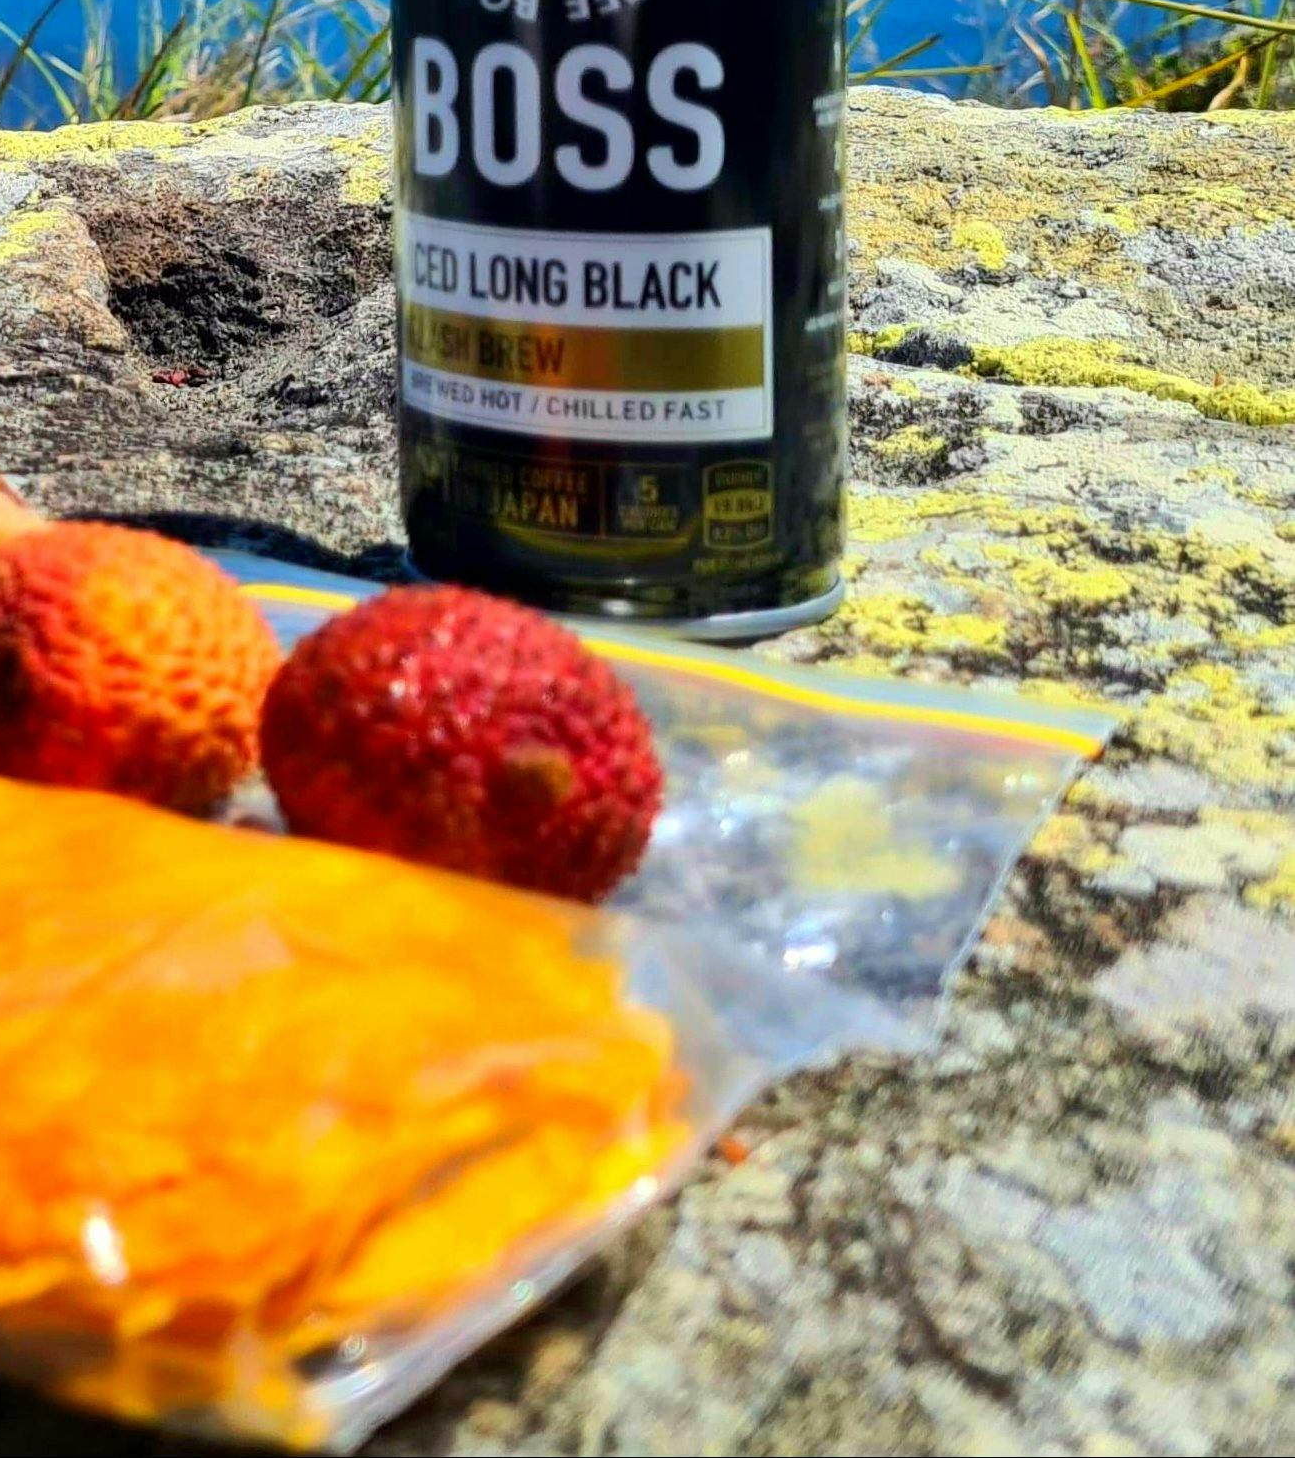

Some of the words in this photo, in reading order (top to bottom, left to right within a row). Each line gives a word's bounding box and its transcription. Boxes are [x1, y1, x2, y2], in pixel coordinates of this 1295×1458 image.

[414, 36, 726, 193] BOSS
[413, 242, 457, 291] CED
[469, 252, 568, 307] LONG
[583, 259, 721, 310] BLACK
[478, 328, 565, 373] BREW
[481, 388, 522, 412] HOT
[546, 392, 656, 421] CHILLED
[664, 398, 725, 421] FAST
[489, 489, 580, 527] JAPAN
